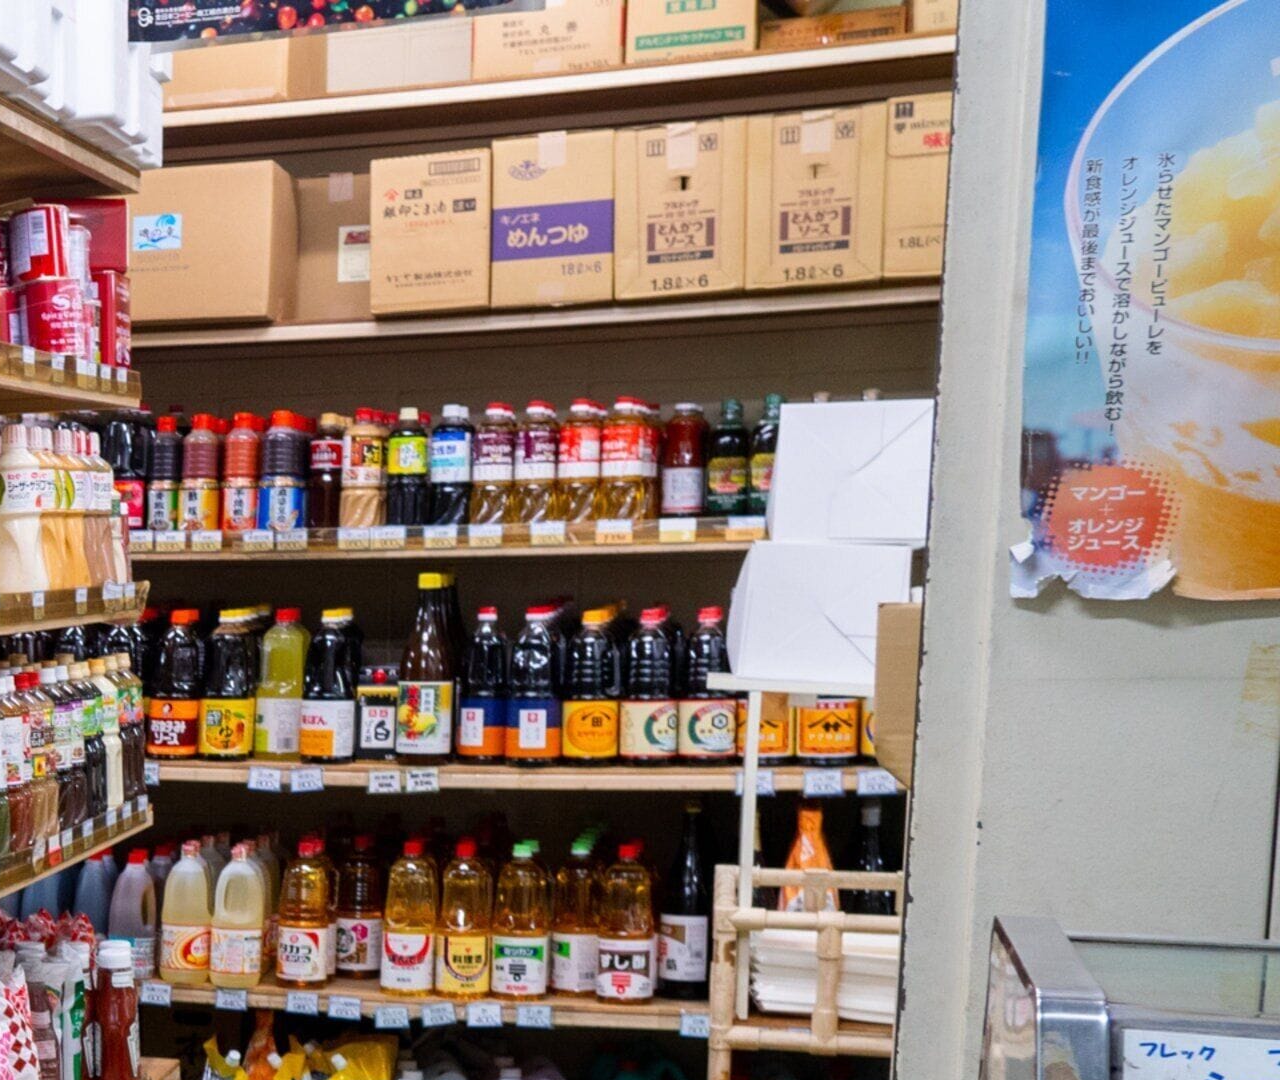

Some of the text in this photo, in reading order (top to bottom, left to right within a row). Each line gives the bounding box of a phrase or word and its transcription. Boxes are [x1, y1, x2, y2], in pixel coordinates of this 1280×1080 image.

[791, 209, 840, 226] とんかつ
[506, 224, 589, 249] めんつゆ
[657, 219, 703, 236] とんかつ
[797, 223, 831, 238] ソース
[664, 234, 697, 248] ソース
[1144, 153, 1175, 357] 氷らせたマンゴーピューレを
[1069, 484, 1146, 502] マンゴー
[1067, 517, 1145, 535] オレンジ
[1067, 534, 1140, 552] ジュース
[600, 952, 646, 970] すし酢
[1139, 1042, 1216, 1061] フレック
